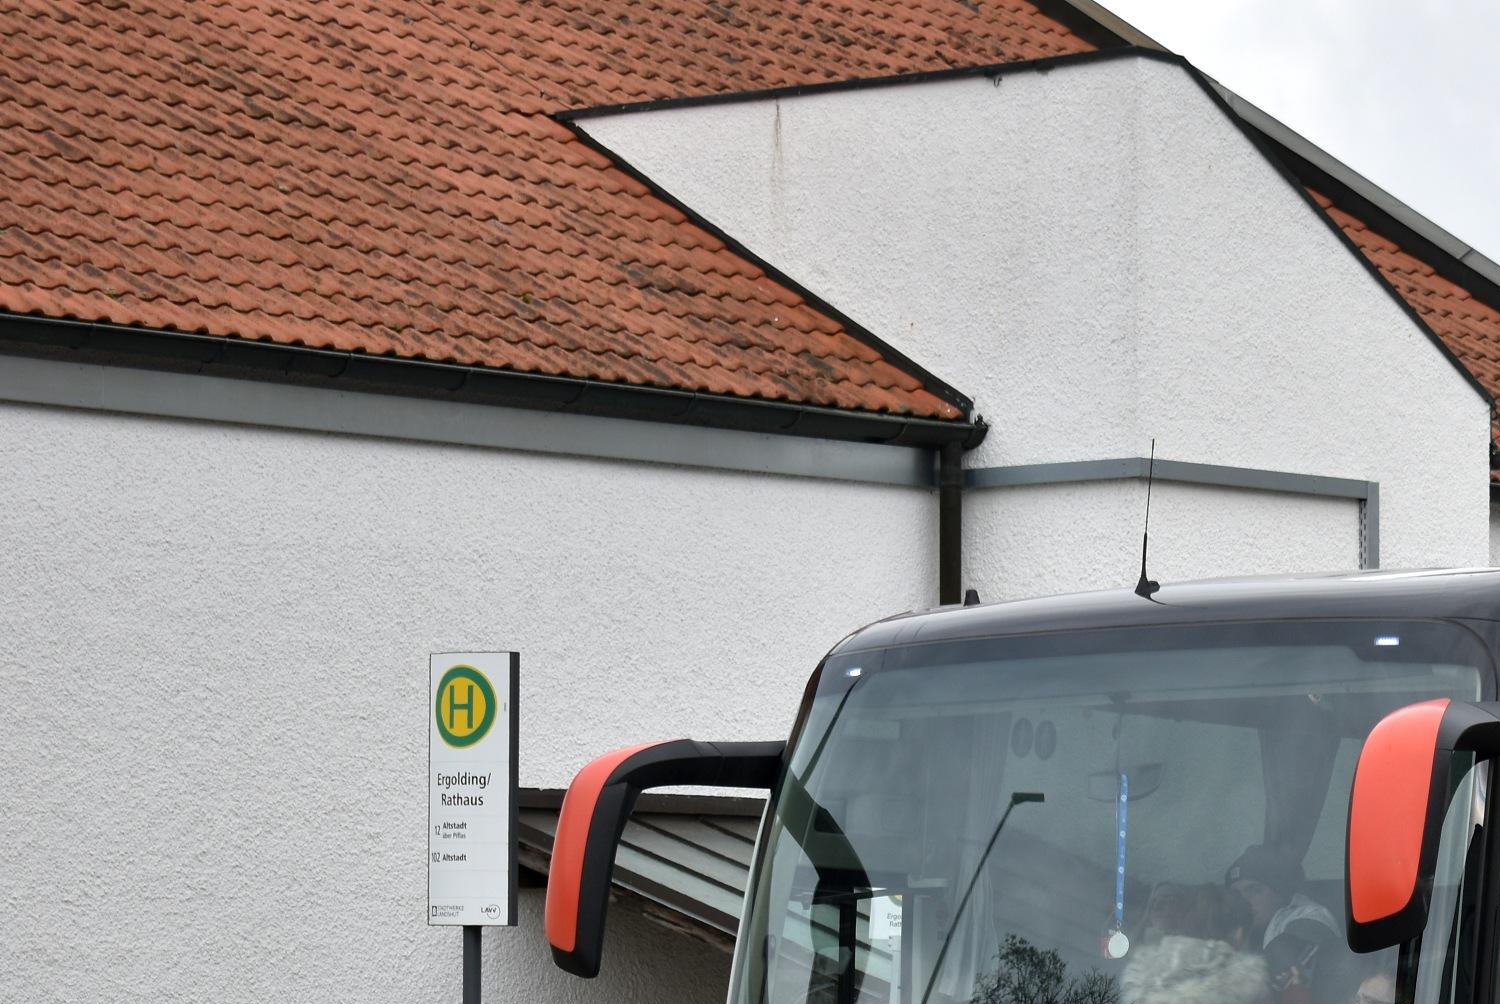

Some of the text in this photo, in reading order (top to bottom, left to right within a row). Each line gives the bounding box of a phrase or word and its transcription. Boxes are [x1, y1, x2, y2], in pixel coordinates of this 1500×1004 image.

[437, 771, 491, 789] Ergolding/
[441, 793, 484, 806] Rathaus
[434, 825, 441, 835] 12
